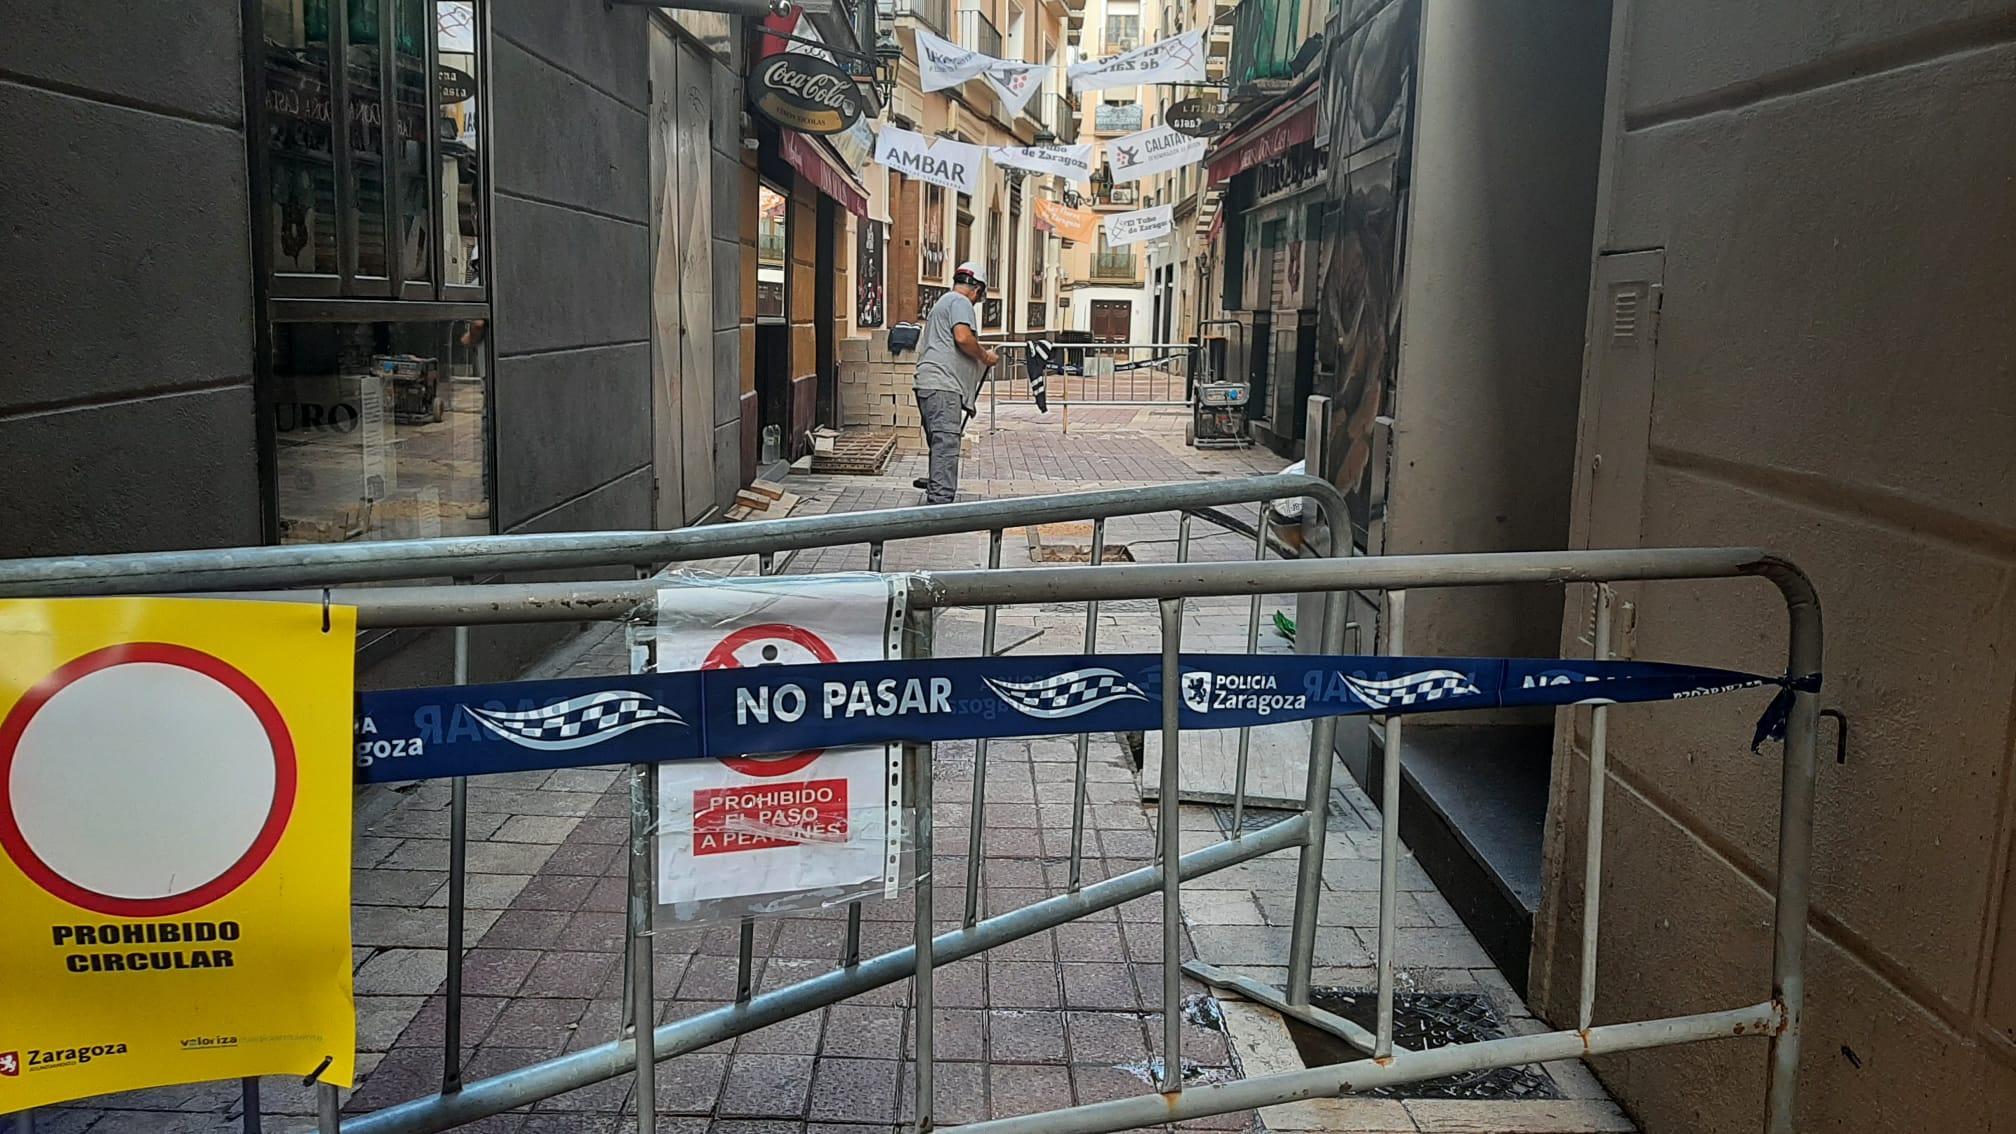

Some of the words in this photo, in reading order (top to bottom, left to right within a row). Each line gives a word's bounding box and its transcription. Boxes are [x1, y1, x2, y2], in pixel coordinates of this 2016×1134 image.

[764, 61, 852, 108] Coca-Cola
[886, 147, 965, 185] AMBAR
[1038, 150, 1088, 169] Zaragoza
[736, 683, 807, 726] NO
[823, 677, 952, 719] PASAR
[1213, 690, 1306, 715] Zaragoza
[709, 787, 833, 810] PROHIBIDO
[759, 807, 818, 826] PASO
[701, 834, 716, 849] A
[52, 921, 240, 946] PROHIBIDO
[66, 949, 235, 973] CIRCULAR
[27, 1042, 128, 1066] Zaragoza
